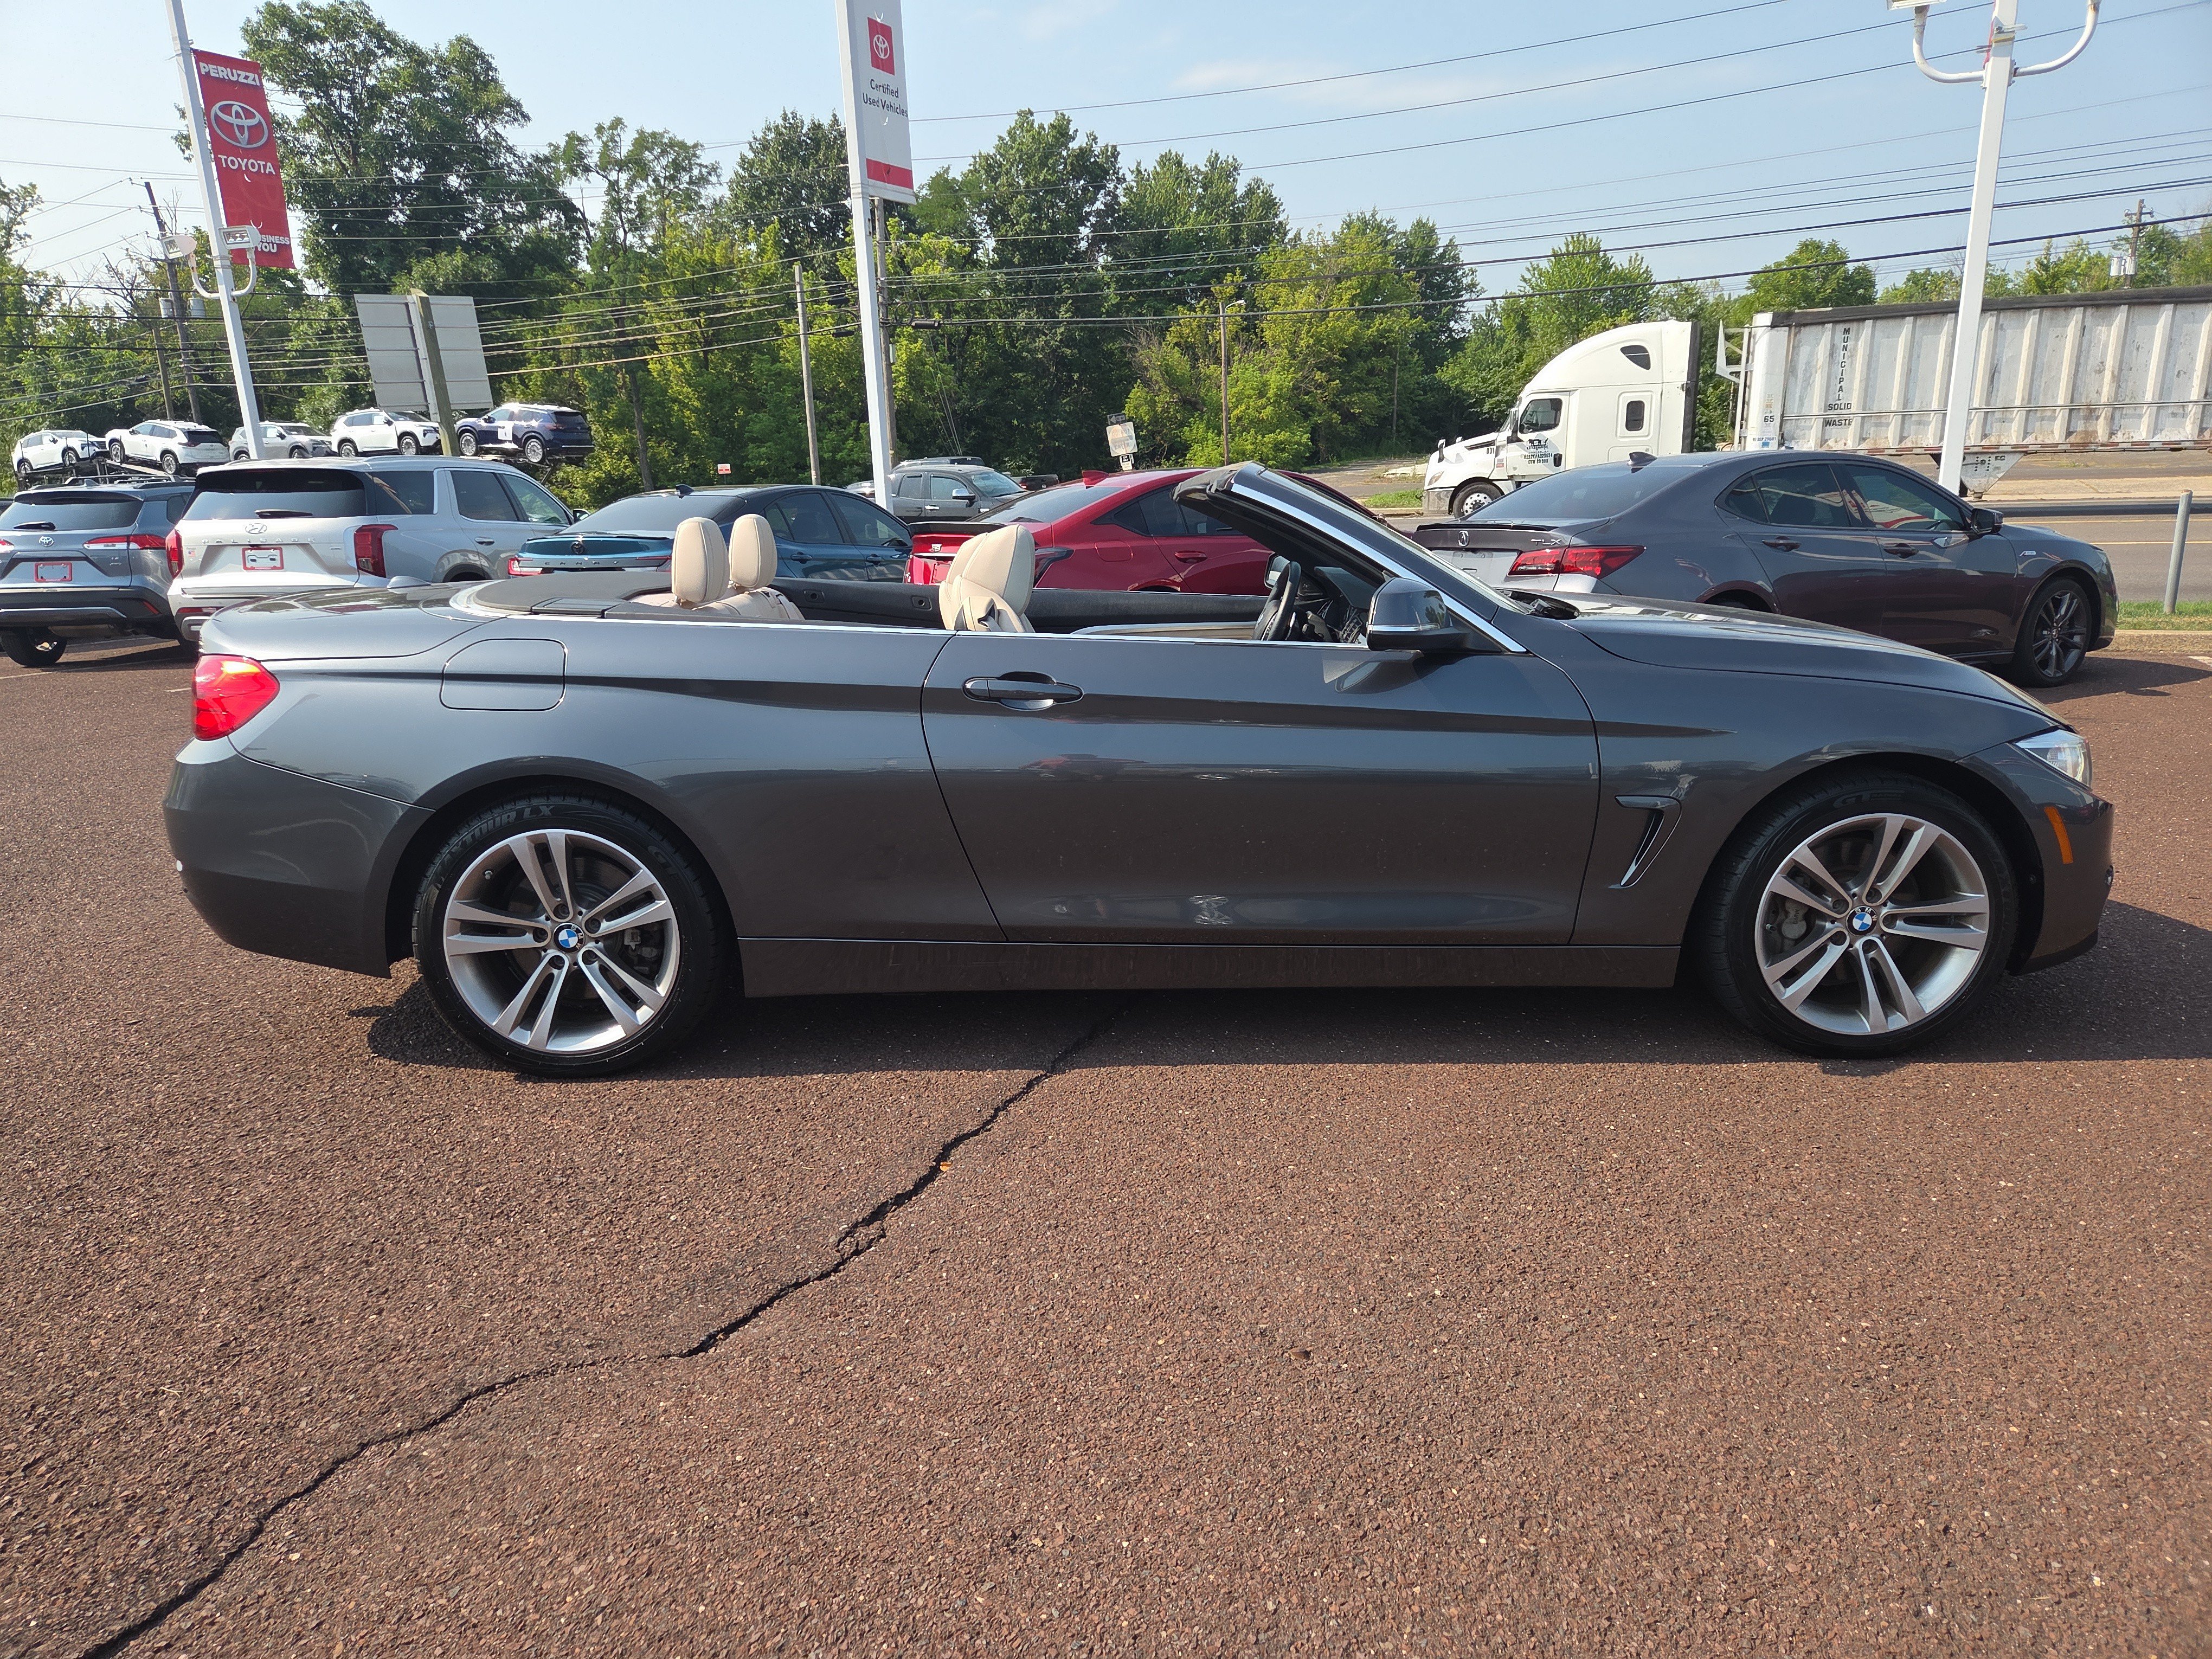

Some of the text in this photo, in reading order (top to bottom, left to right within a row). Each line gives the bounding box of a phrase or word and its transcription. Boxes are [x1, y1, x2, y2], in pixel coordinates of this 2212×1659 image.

[199, 62, 260, 86] PERUZZI
[870, 79, 899, 99] Certified
[863, 92, 909, 118] Used Vehicles
[218, 155, 276, 175] TOYOTA
[261, 234, 290, 245] SINESS
[1837, 327, 1850, 401] MUNICIPAL
[1825, 419, 1853, 427] WASTE
[523, 805, 555, 819] LX
[1855, 908, 1877, 921] BMW
[571, 924, 584, 949] BMW
